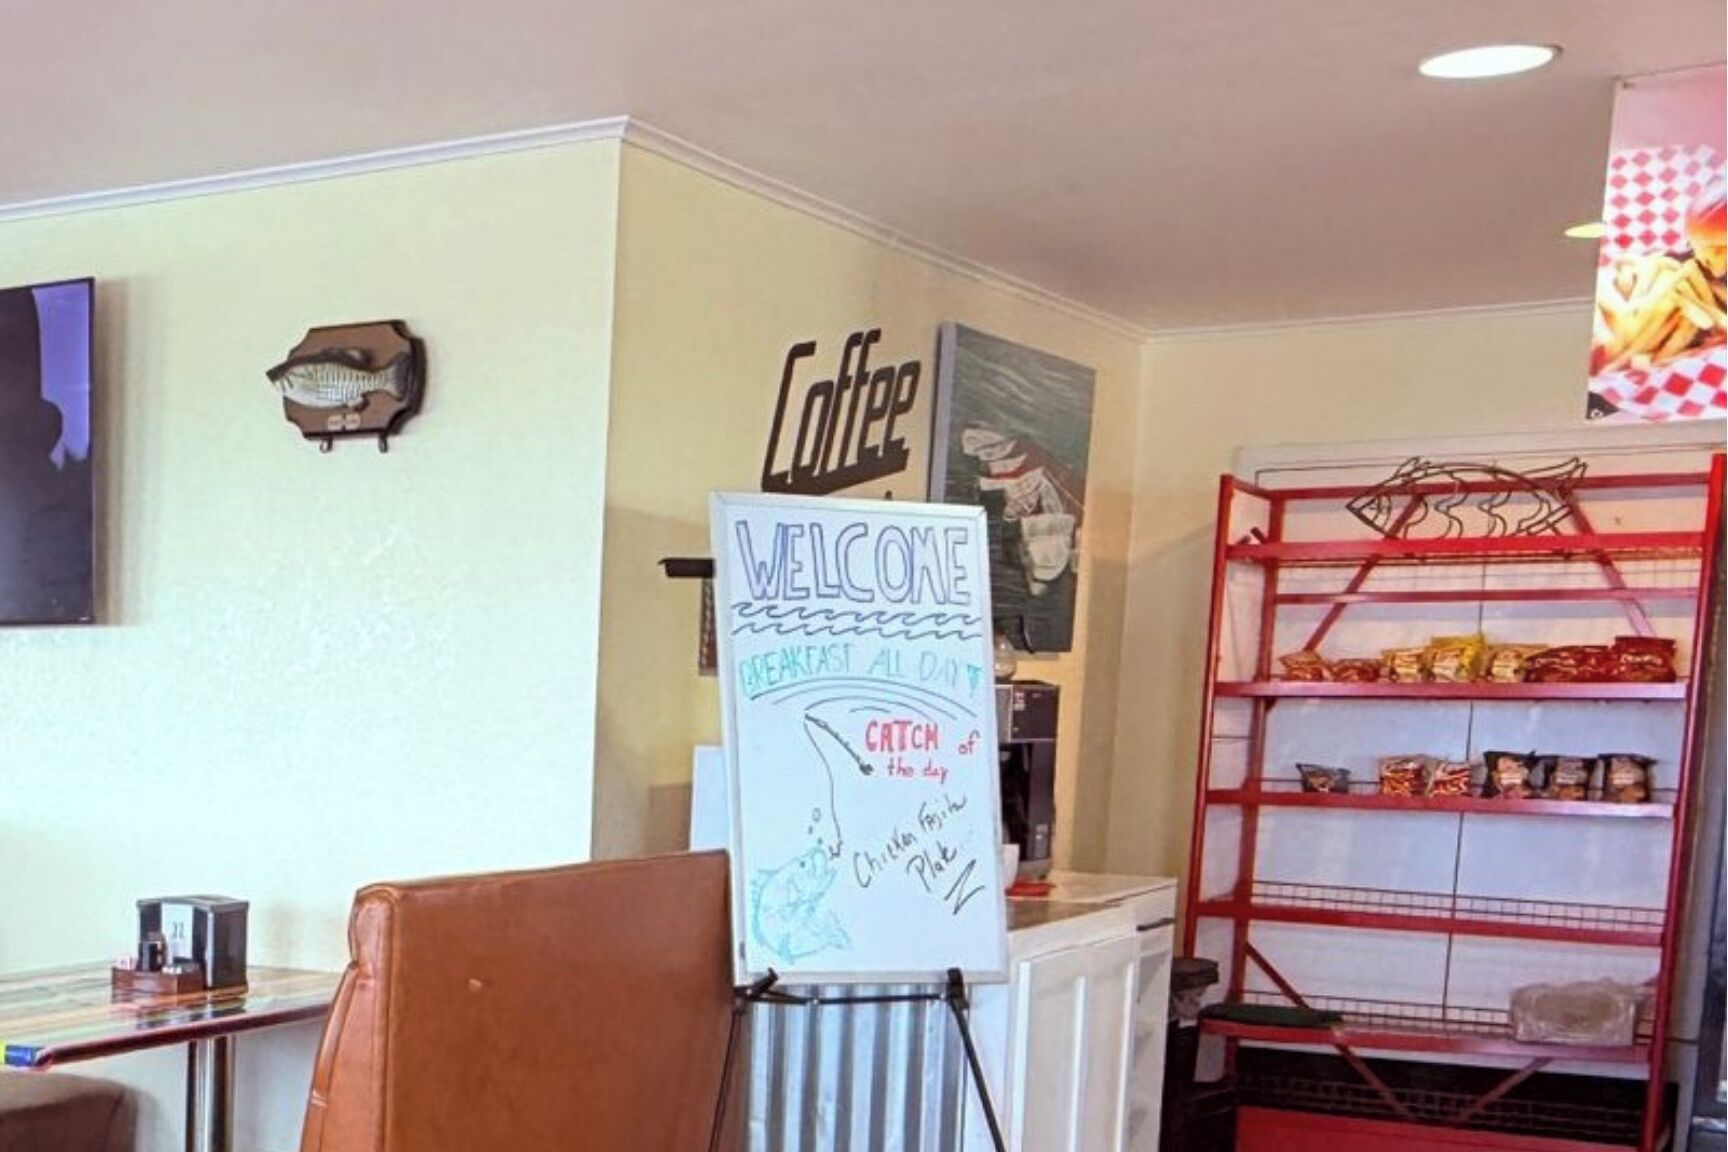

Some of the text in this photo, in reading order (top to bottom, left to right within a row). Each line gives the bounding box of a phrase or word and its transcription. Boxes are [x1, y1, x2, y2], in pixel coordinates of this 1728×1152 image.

[761, 327, 922, 492] Coffee
[735, 519, 971, 605] WELCOME
[865, 718, 982, 755] CATCH of
[887, 756, 950, 785] the day
